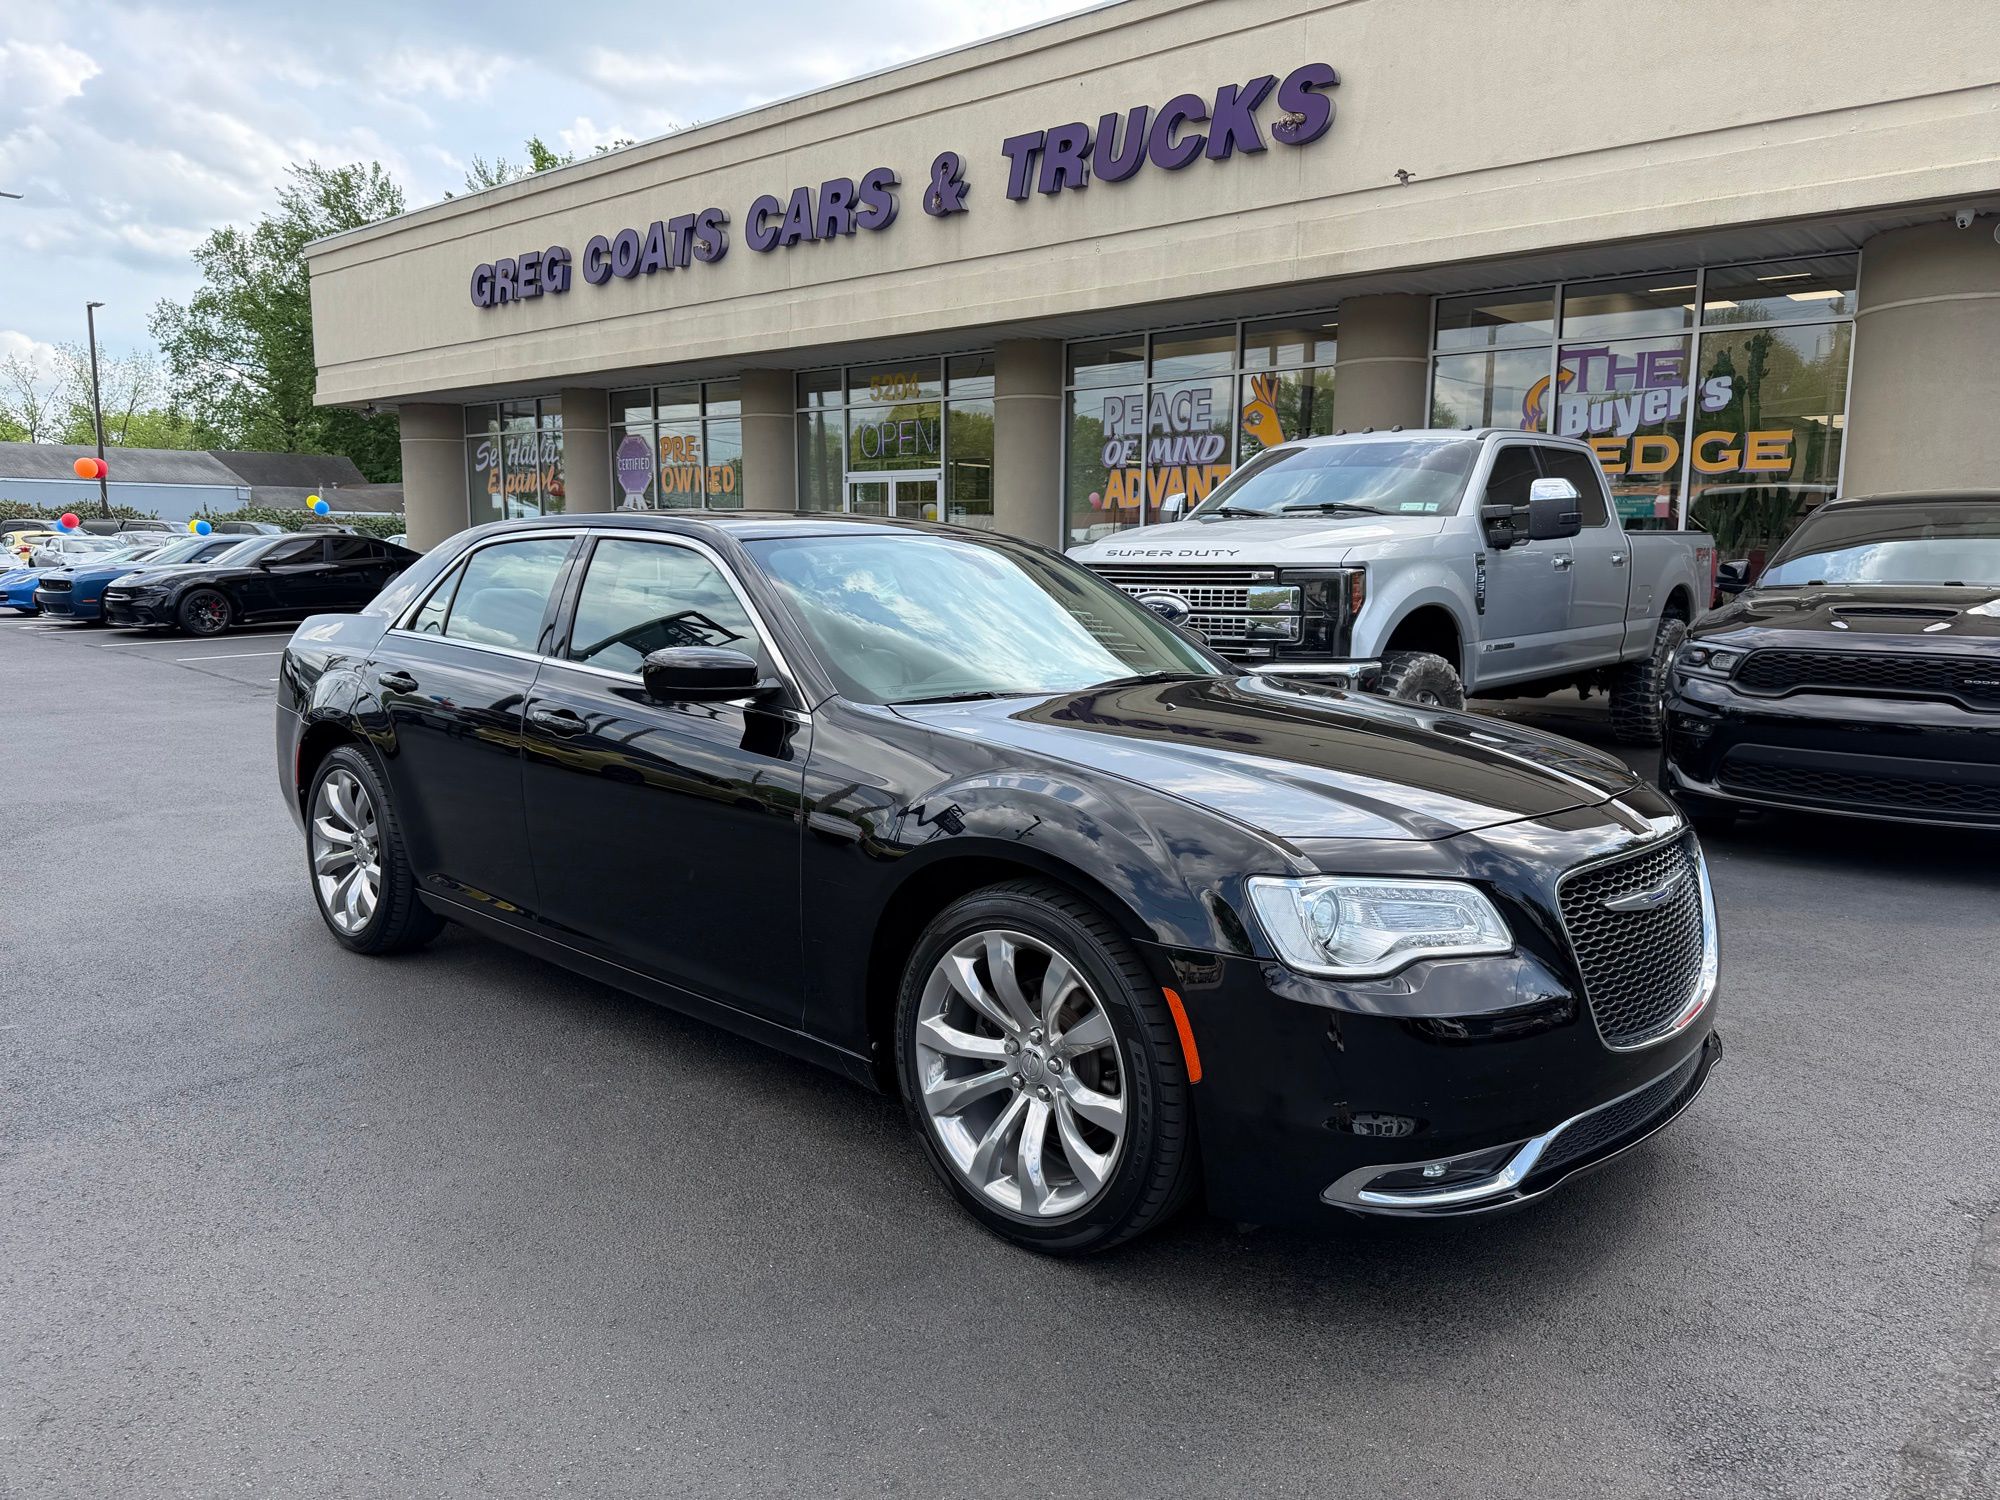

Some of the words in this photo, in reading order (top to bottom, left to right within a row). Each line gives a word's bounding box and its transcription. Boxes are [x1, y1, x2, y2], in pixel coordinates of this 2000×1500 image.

[470, 245, 571, 308] GREG
[582, 207, 730, 285] COATS
[745, 166, 900, 253] CARS
[923, 150, 970, 217] &
[1001, 62, 1341, 201] TRUCKS
[1559, 346, 1685, 394] THE
[869, 371, 921, 402] 5204
[1103, 388, 1212, 436] PEACE
[660, 435, 702, 464] PRE-
[861, 419, 934, 458] OPEN
[1102, 439, 1138, 468] OF
[1147, 434, 1226, 467] MIND
[1588, 429, 1794, 475] EDGE
[475, 441, 499, 472] Se
[617, 457, 650, 472] CERTIFIED
[661, 465, 735, 494] OWNED
[1105, 549, 1173, 557] SUPER
[1178, 549, 1240, 557] DUTY
